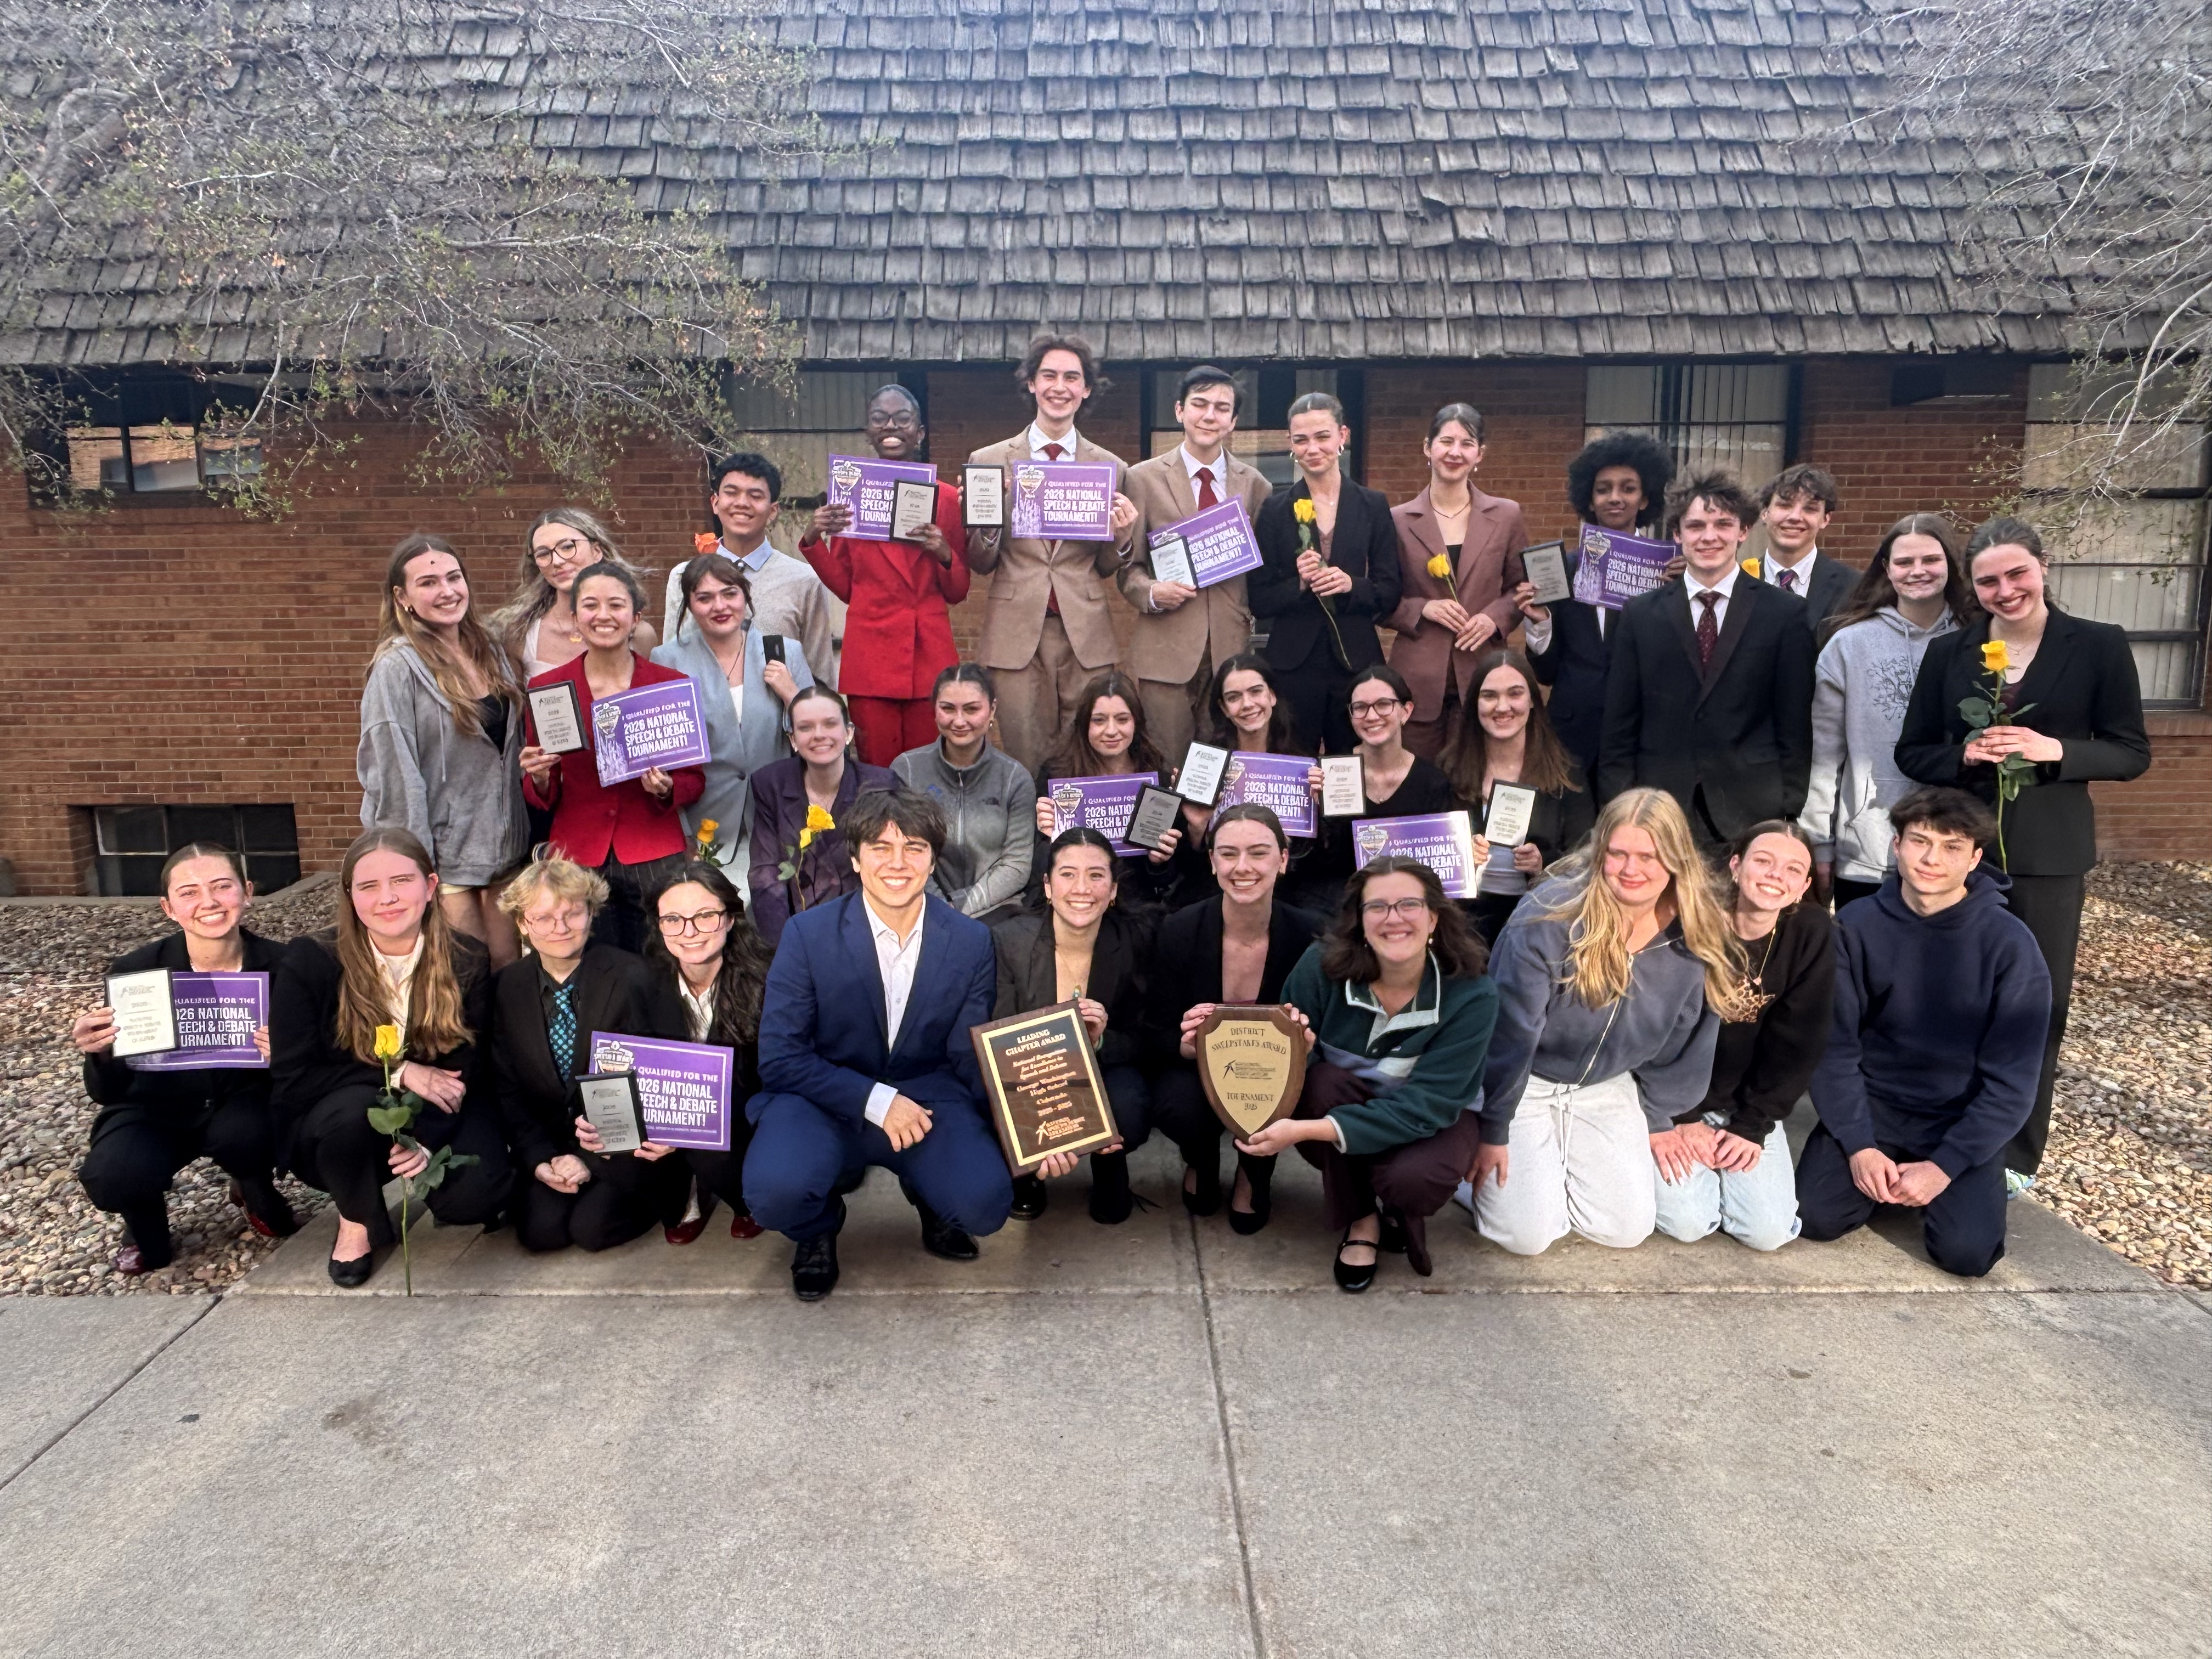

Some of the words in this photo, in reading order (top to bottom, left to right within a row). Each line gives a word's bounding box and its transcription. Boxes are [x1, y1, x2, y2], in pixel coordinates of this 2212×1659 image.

[861, 487, 883, 499] 2026
[1043, 489, 1065, 500] 2026
[1066, 489, 1103, 500] NATIONAL
[860, 499, 889, 511] SPEECH
[1043, 500, 1070, 511] SPEECH
[1071, 501, 1077, 511] &
[1078, 501, 1106, 511] DEBATE
[860, 510, 891, 523] TOURNA
[1043, 511, 1098, 522] TOURNAMENT!
[1189, 540, 1204, 554] 026
[1204, 526, 1240, 547] NATIONAL
[1191, 548, 1214, 563] PEECH
[1218, 533, 1246, 552] DEBATE
[1607, 558, 1627, 572] 2026
[1606, 569, 1632, 583] SPEECH
[662, 702, 676, 712] FOR
[623, 717, 646, 735] 2026
[647, 710, 690, 731] NATIONAL
[625, 727, 656, 747] SPEECH
[656, 726, 663, 740] &
[663, 720, 696, 739] DEBATE
[627, 735, 688, 758] TOURNAMENT!
[1244, 781, 1266, 792] 2026
[1268, 782, 1306, 795] NATIONAL
[1244, 792, 1273, 804] SPEECH
[1273, 794, 1279, 804] &
[1280, 794, 1309, 806] DEBATE
[1085, 806, 1107, 818] 2026
[1108, 804, 1135, 816] NATIO
[1085, 817, 1114, 829] SPEECH
[1115, 816, 1122, 827] &
[1415, 843, 1457, 858] NATIONAL
[1430, 855, 1462, 868] DEBATE
[198, 1007, 252, 1020] NATIONAL
[178, 1020, 206, 1034] EECH
[208, 1020, 216, 1032] &
[218, 1020, 257, 1032] DEBATE
[1231, 1027, 1266, 1037] DISTRICT
[180, 1033, 246, 1047] URNAMENT!
[1017, 1029, 1050, 1043] LEADING
[1005, 1041, 1040, 1056] CHAPTER
[1041, 1033, 1066, 1046] AWARD
[638, 1066, 681, 1078] QUALIFIED
[683, 1072, 700, 1080] FOR
[702, 1074, 718, 1082] THE
[636, 1078, 659, 1093] 026
[662, 1080, 713, 1099] NATIONAL
[640, 1093, 669, 1109] PEECH
[670, 1097, 677, 1110] &
[679, 1097, 718, 1114] DEBATE
[1227, 1092, 1274, 1102] TOURNAMENT
[644, 1109, 706, 1126] URNAMENT!
